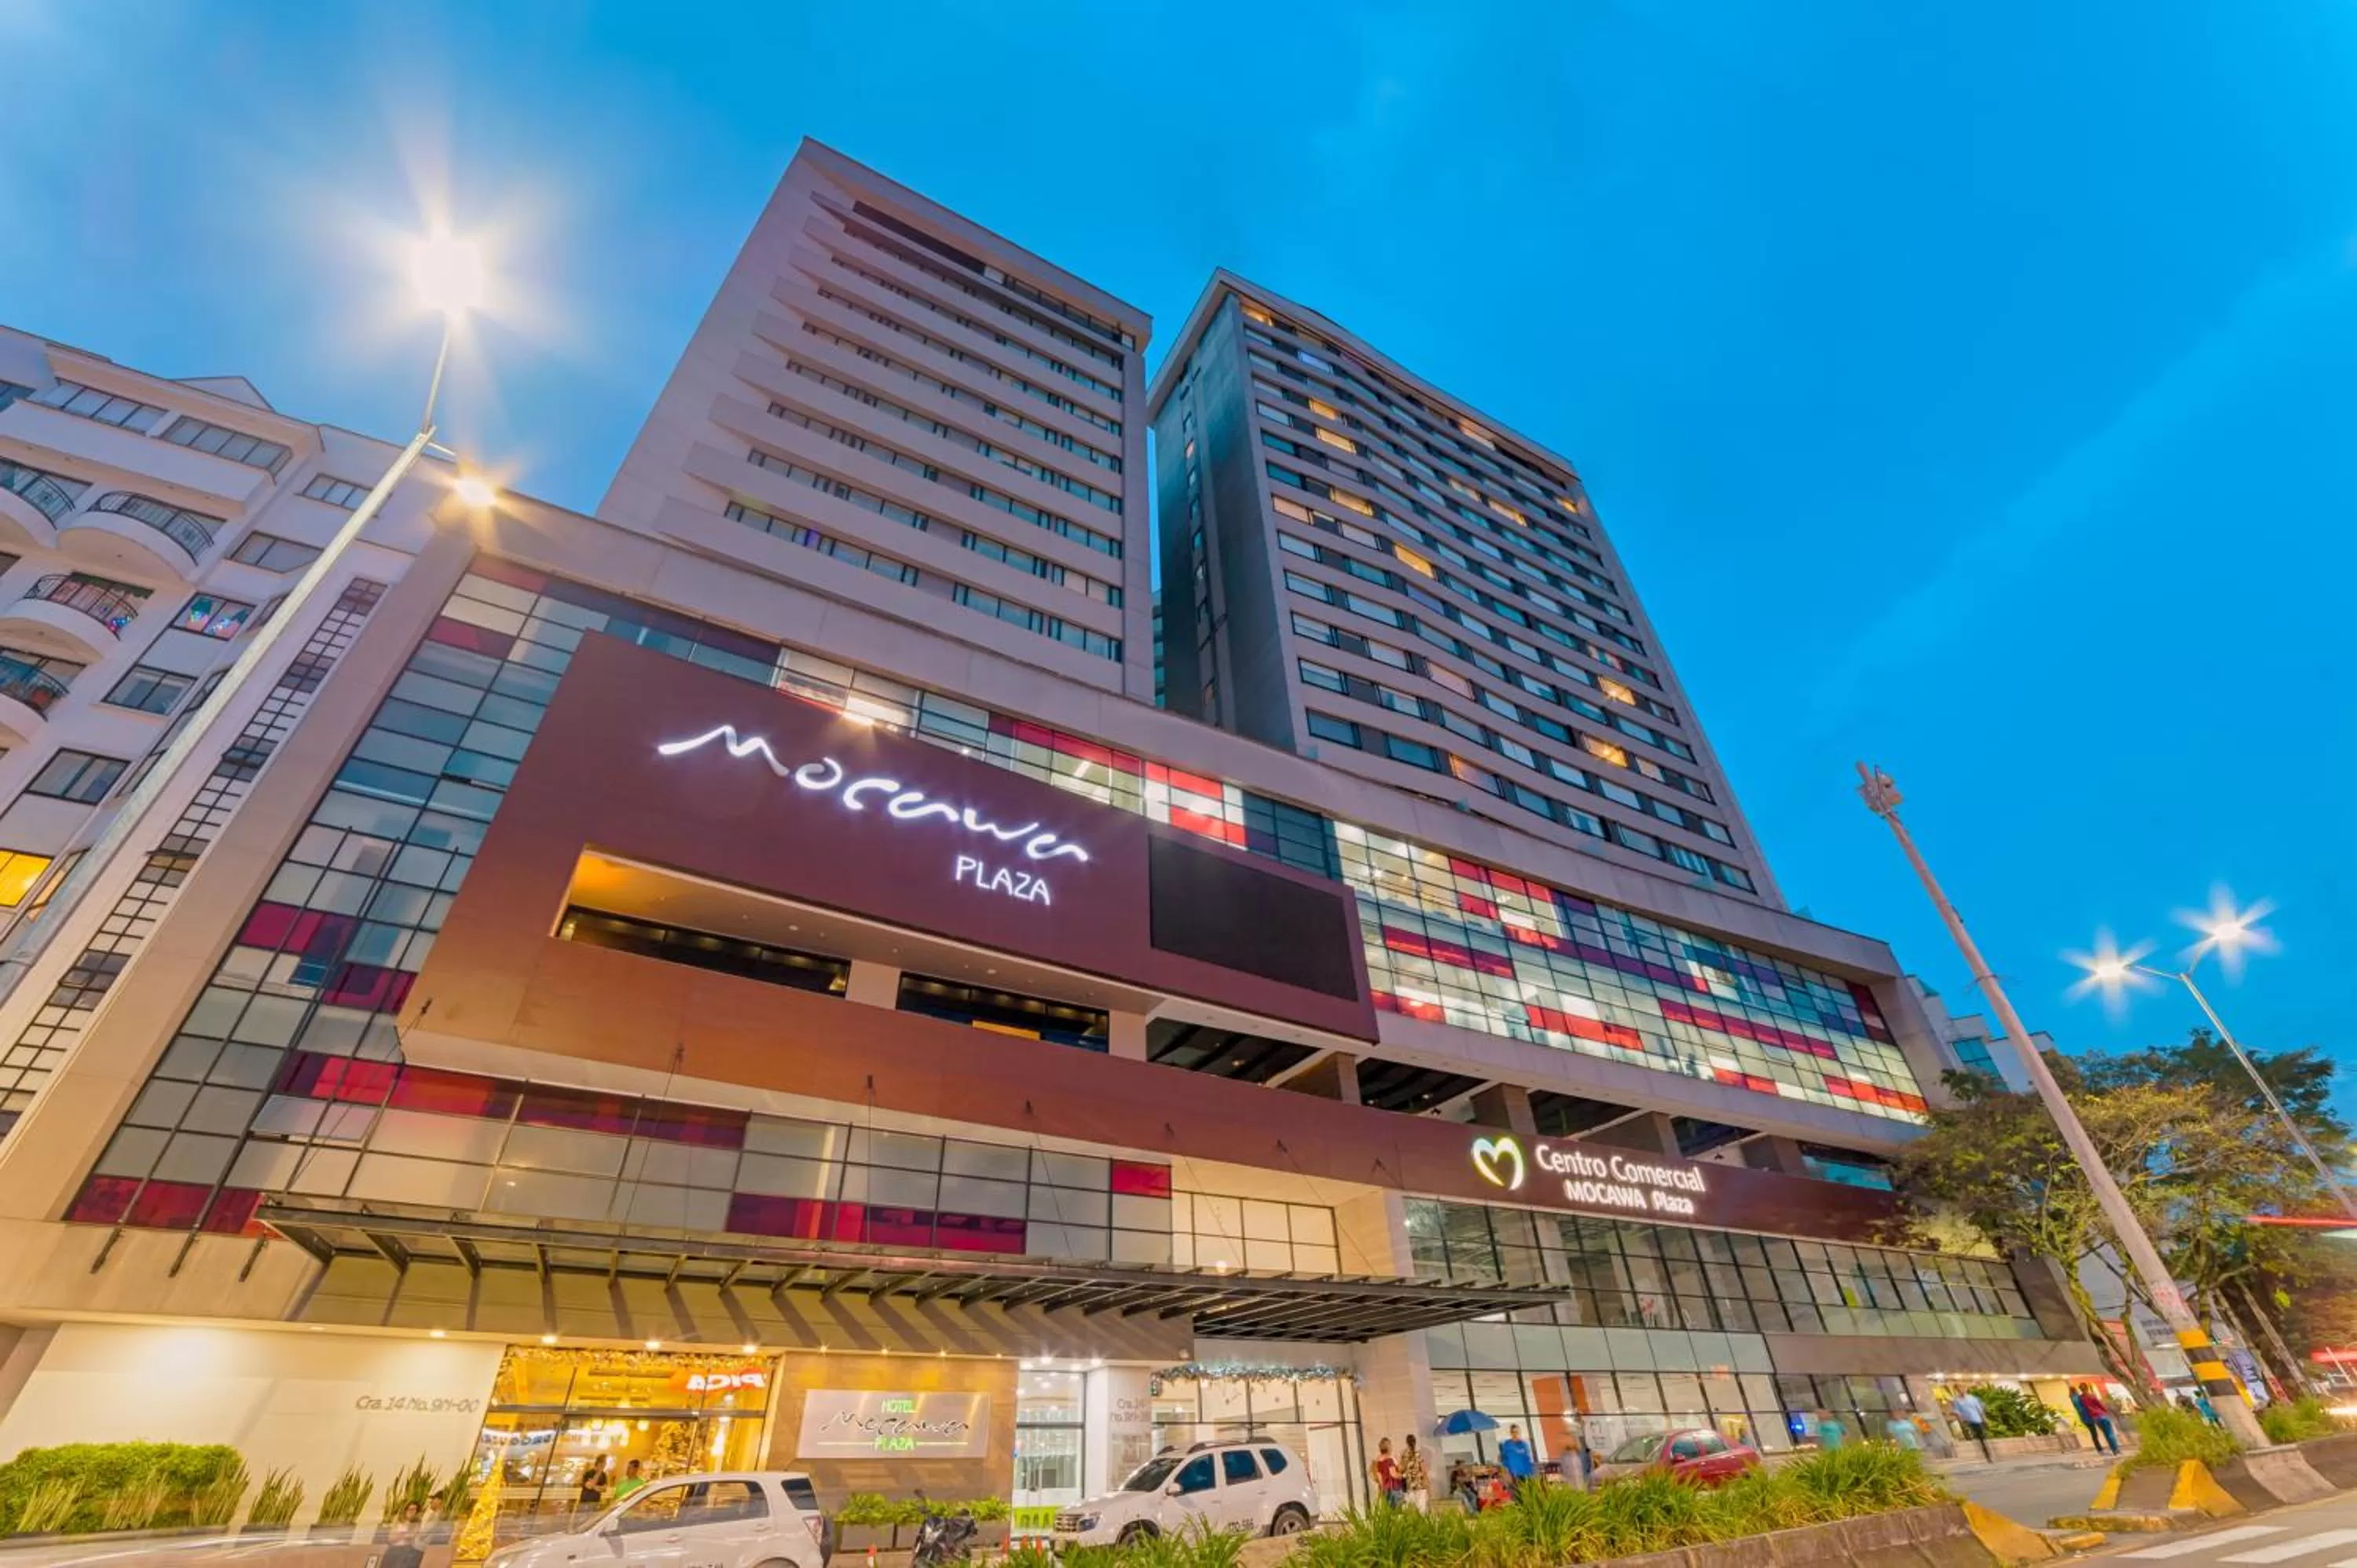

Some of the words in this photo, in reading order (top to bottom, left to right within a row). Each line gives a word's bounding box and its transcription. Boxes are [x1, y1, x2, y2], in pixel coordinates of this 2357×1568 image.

[955, 855, 1050, 906] PLAZA
[1534, 1144, 1606, 1178] Centro
[1610, 1155, 1706, 1192] Comercial
[1564, 1179, 1647, 1210] MOCAWA
[1651, 1191, 1695, 1214] Plaza
[881, 1399, 916, 1414] HOTEL
[873, 1436, 915, 1452] PLAZA
